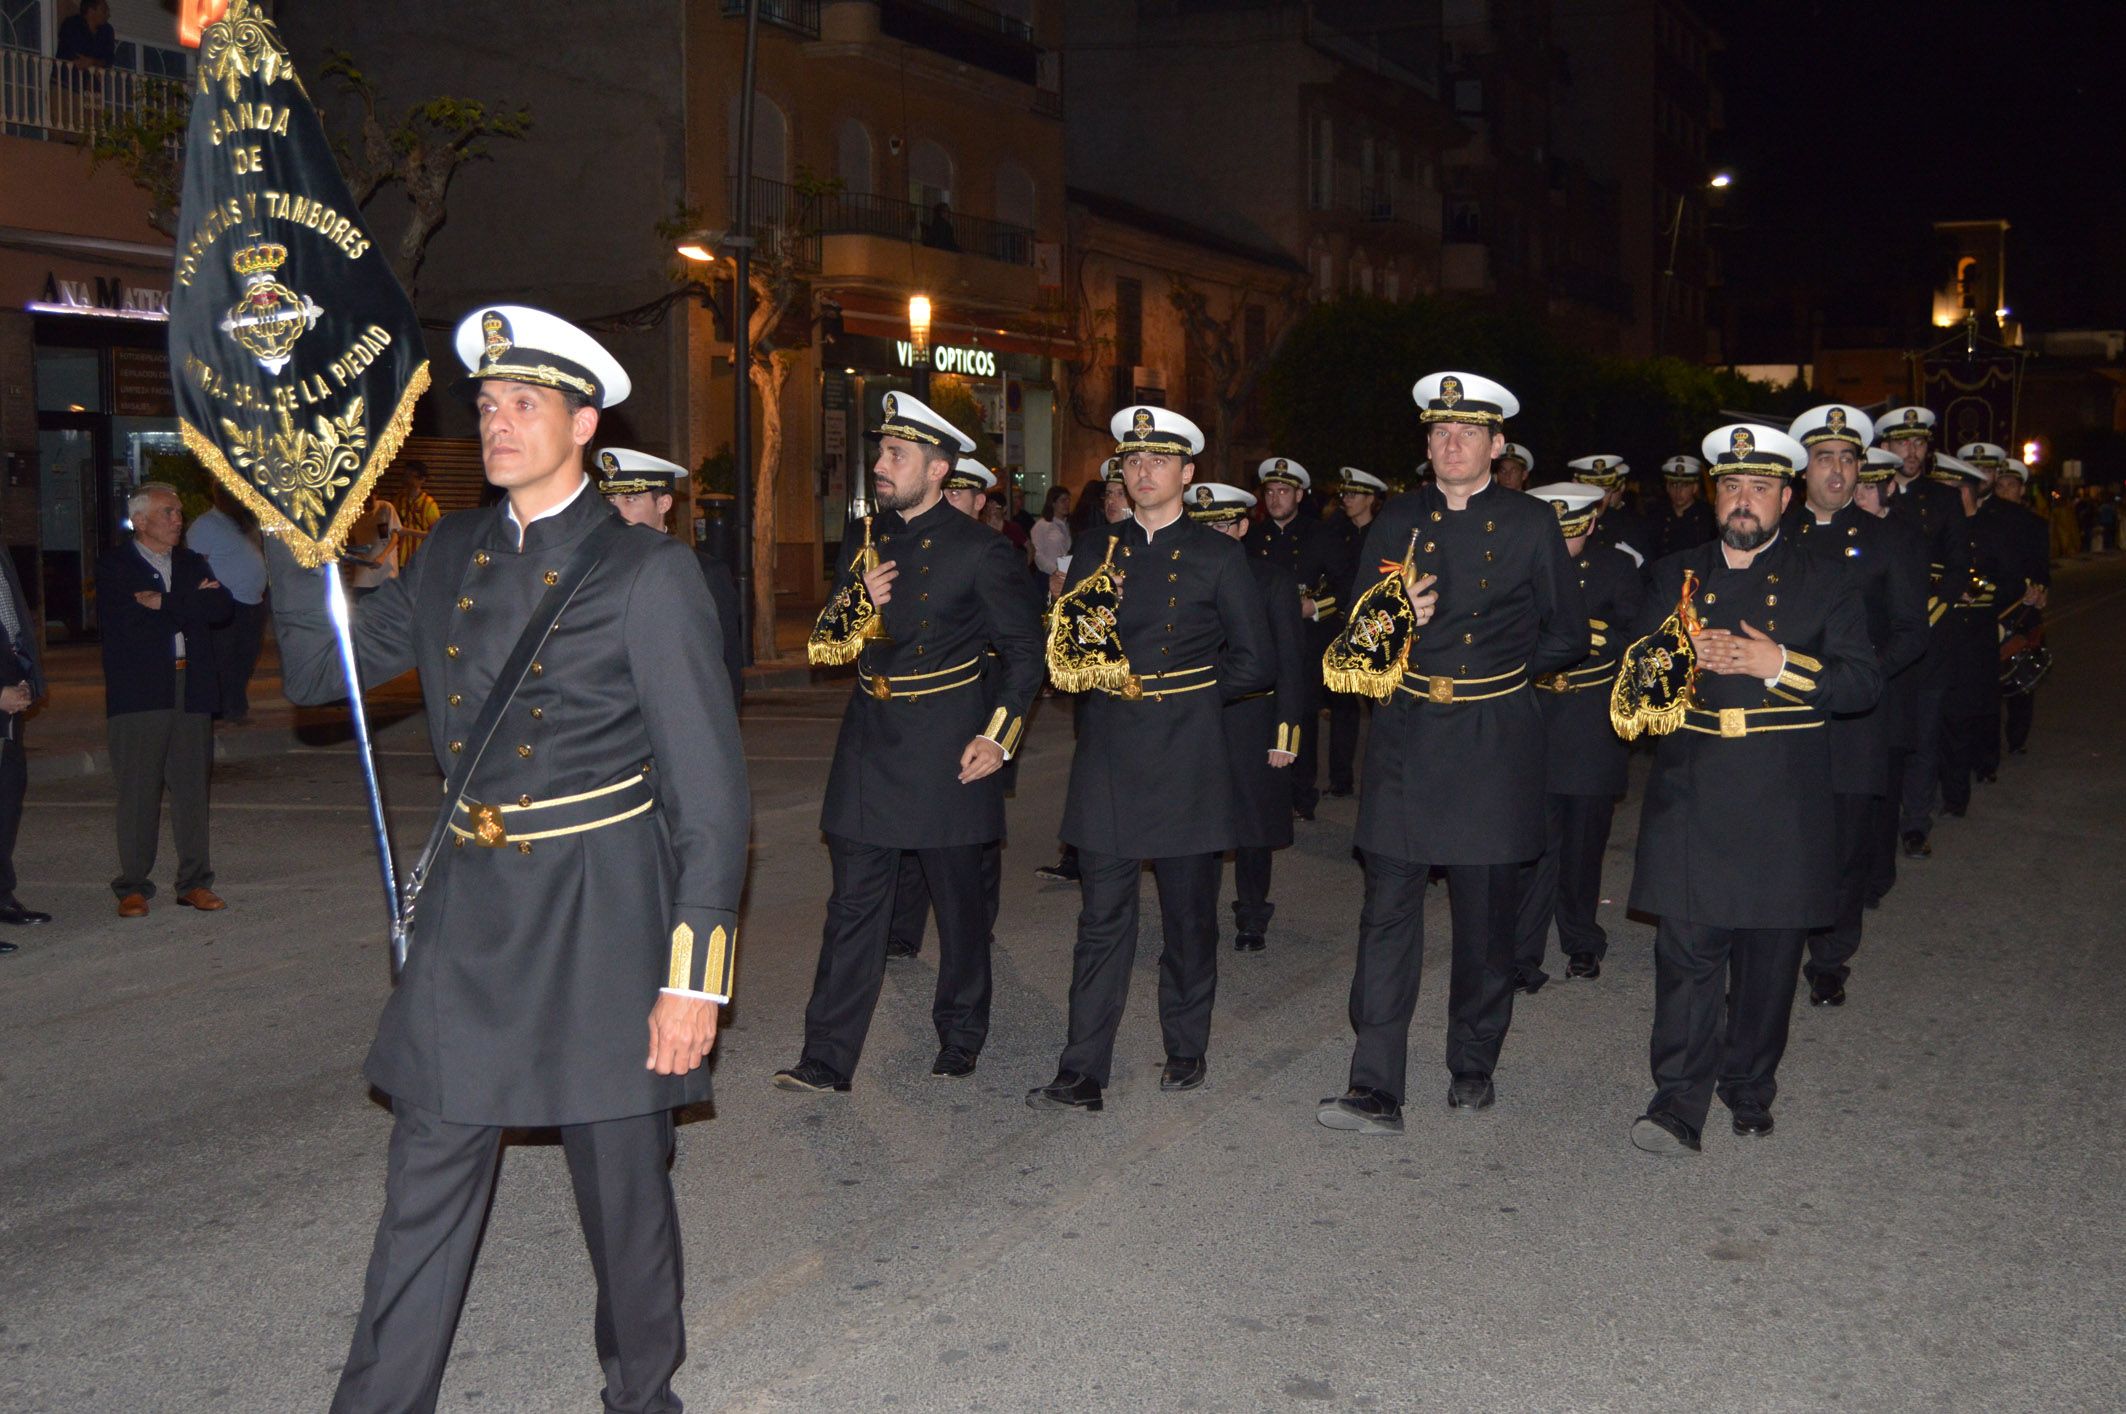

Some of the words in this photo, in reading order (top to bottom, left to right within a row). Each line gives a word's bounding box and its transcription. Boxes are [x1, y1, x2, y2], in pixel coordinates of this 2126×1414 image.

[234, 145, 264, 175] DE
[246, 193, 257, 219] Y
[262, 191, 371, 260] TAMBORES
[272, 385, 299, 412] DE
[301, 374, 332, 404] LA
[328, 324, 392, 387] PIEDAD
[935, 345, 996, 377] OPTICOS
